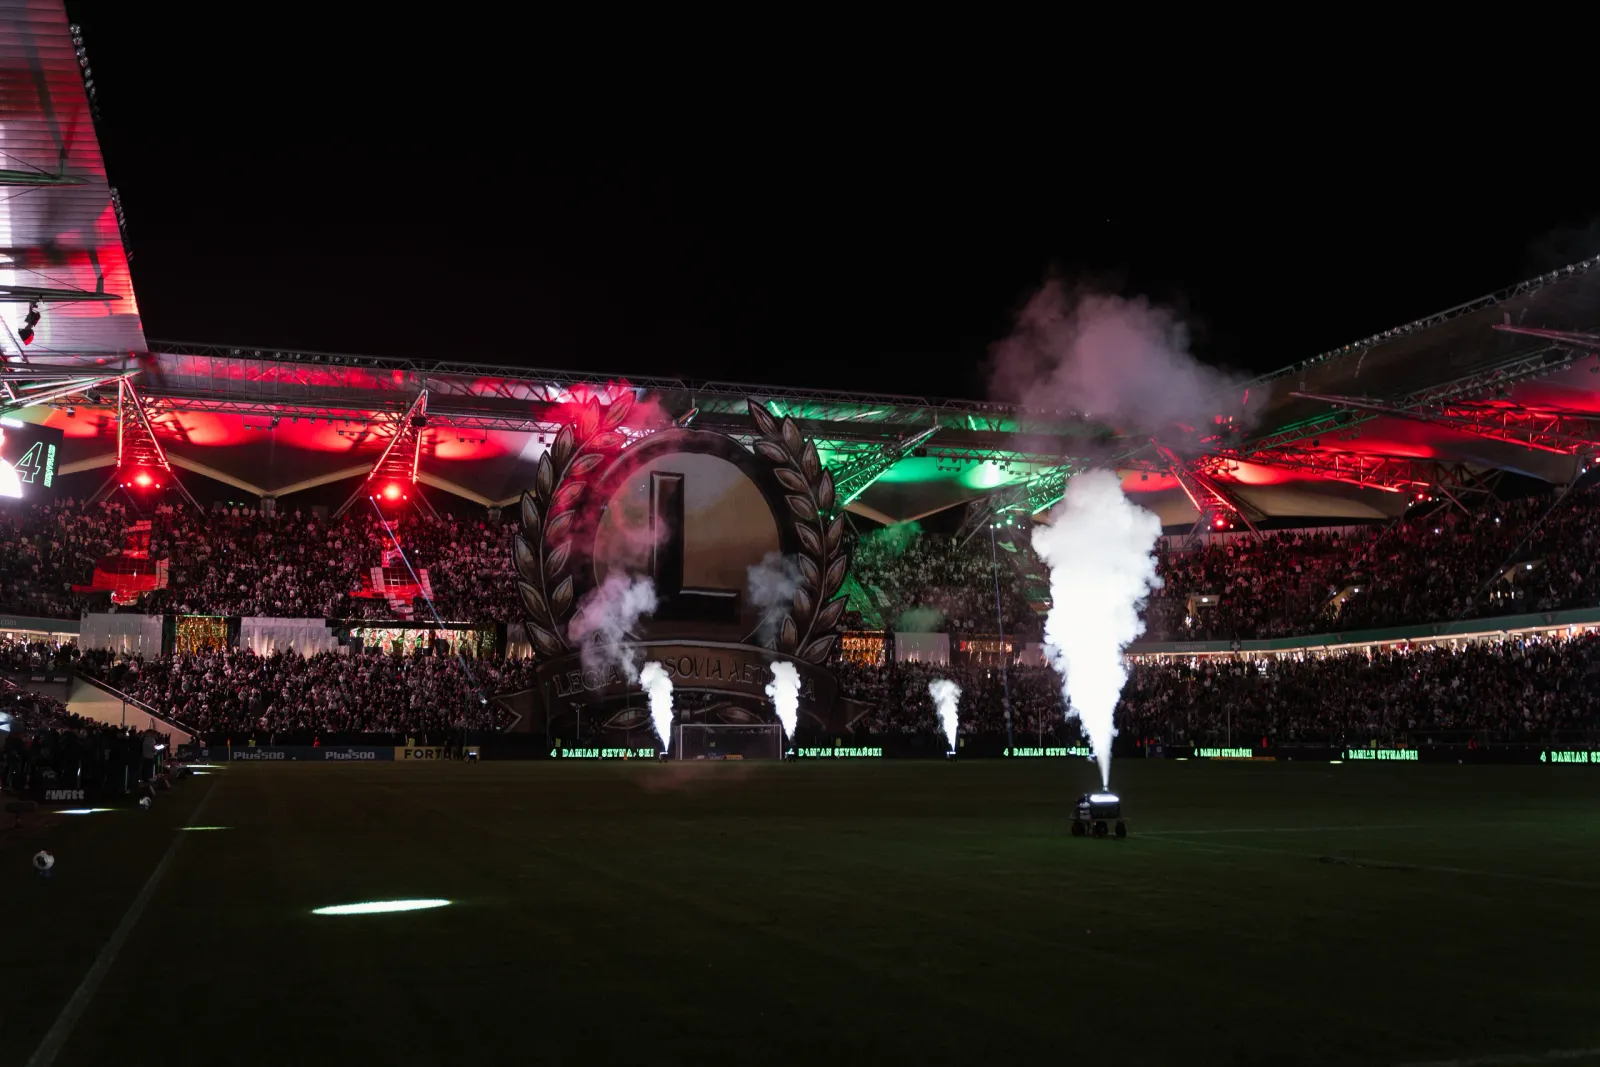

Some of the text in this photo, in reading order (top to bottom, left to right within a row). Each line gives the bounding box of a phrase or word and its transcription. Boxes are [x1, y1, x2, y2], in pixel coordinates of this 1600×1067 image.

[13, 441, 43, 484] 4
[649, 470, 742, 621] L
[552, 664, 622, 698] LEGIA
[728, 662, 816, 702] AETA
[233, 750, 285, 760] Plus500
[325, 750, 376, 760] Plus500
[550, 747, 655, 758] 4 DAMIAN SZYMASKI
[834, 746, 882, 757] SZYMAŃSKI
[1003, 746, 1090, 757] 4 DAMIAN SZYMSKI
[1193, 748, 1198, 757] 4
[1199, 748, 1221, 757] DAMIAN
[1376, 748, 1418, 761] SZYMAŃSKI
[1539, 751, 1547, 763] 4
[1550, 751, 1588, 763] DAMIAN
